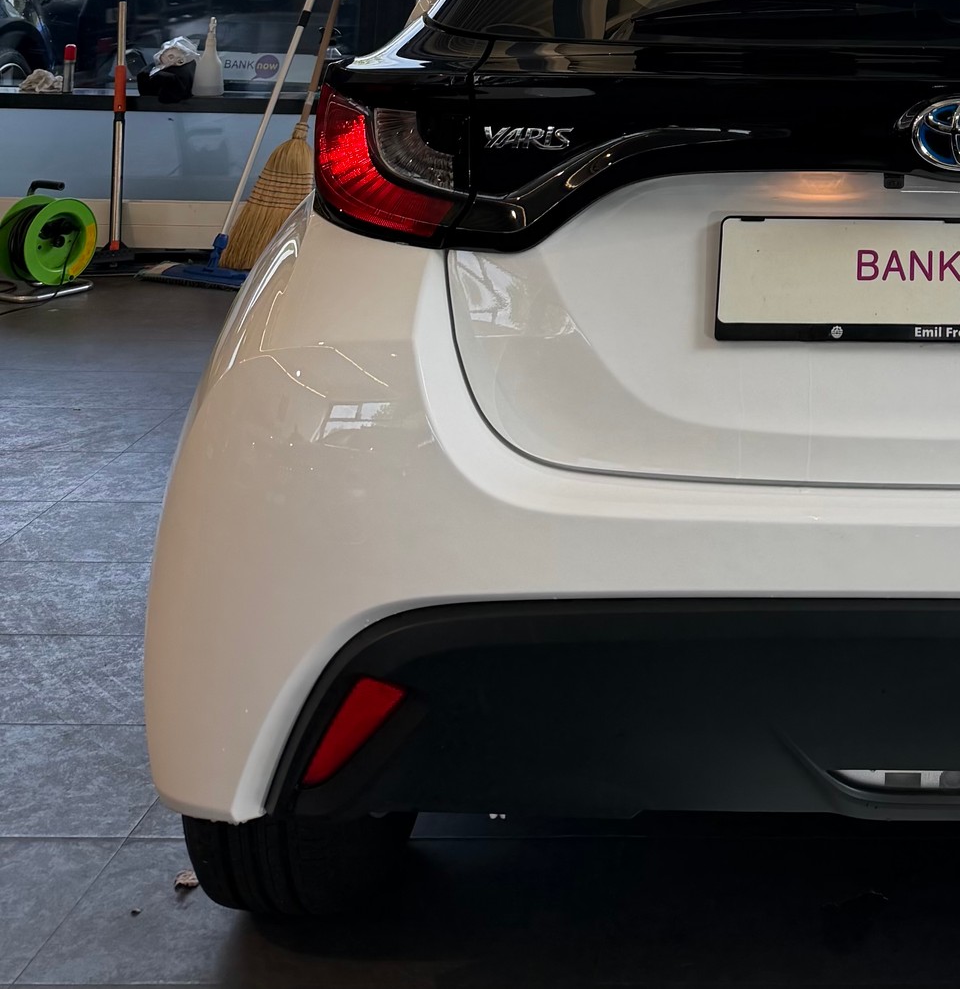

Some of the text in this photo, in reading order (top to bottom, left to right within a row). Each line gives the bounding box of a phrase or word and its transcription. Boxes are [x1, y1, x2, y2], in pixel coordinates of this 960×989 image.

[224, 59, 279, 71] BANK now
[914, 326, 943, 338] Emil
